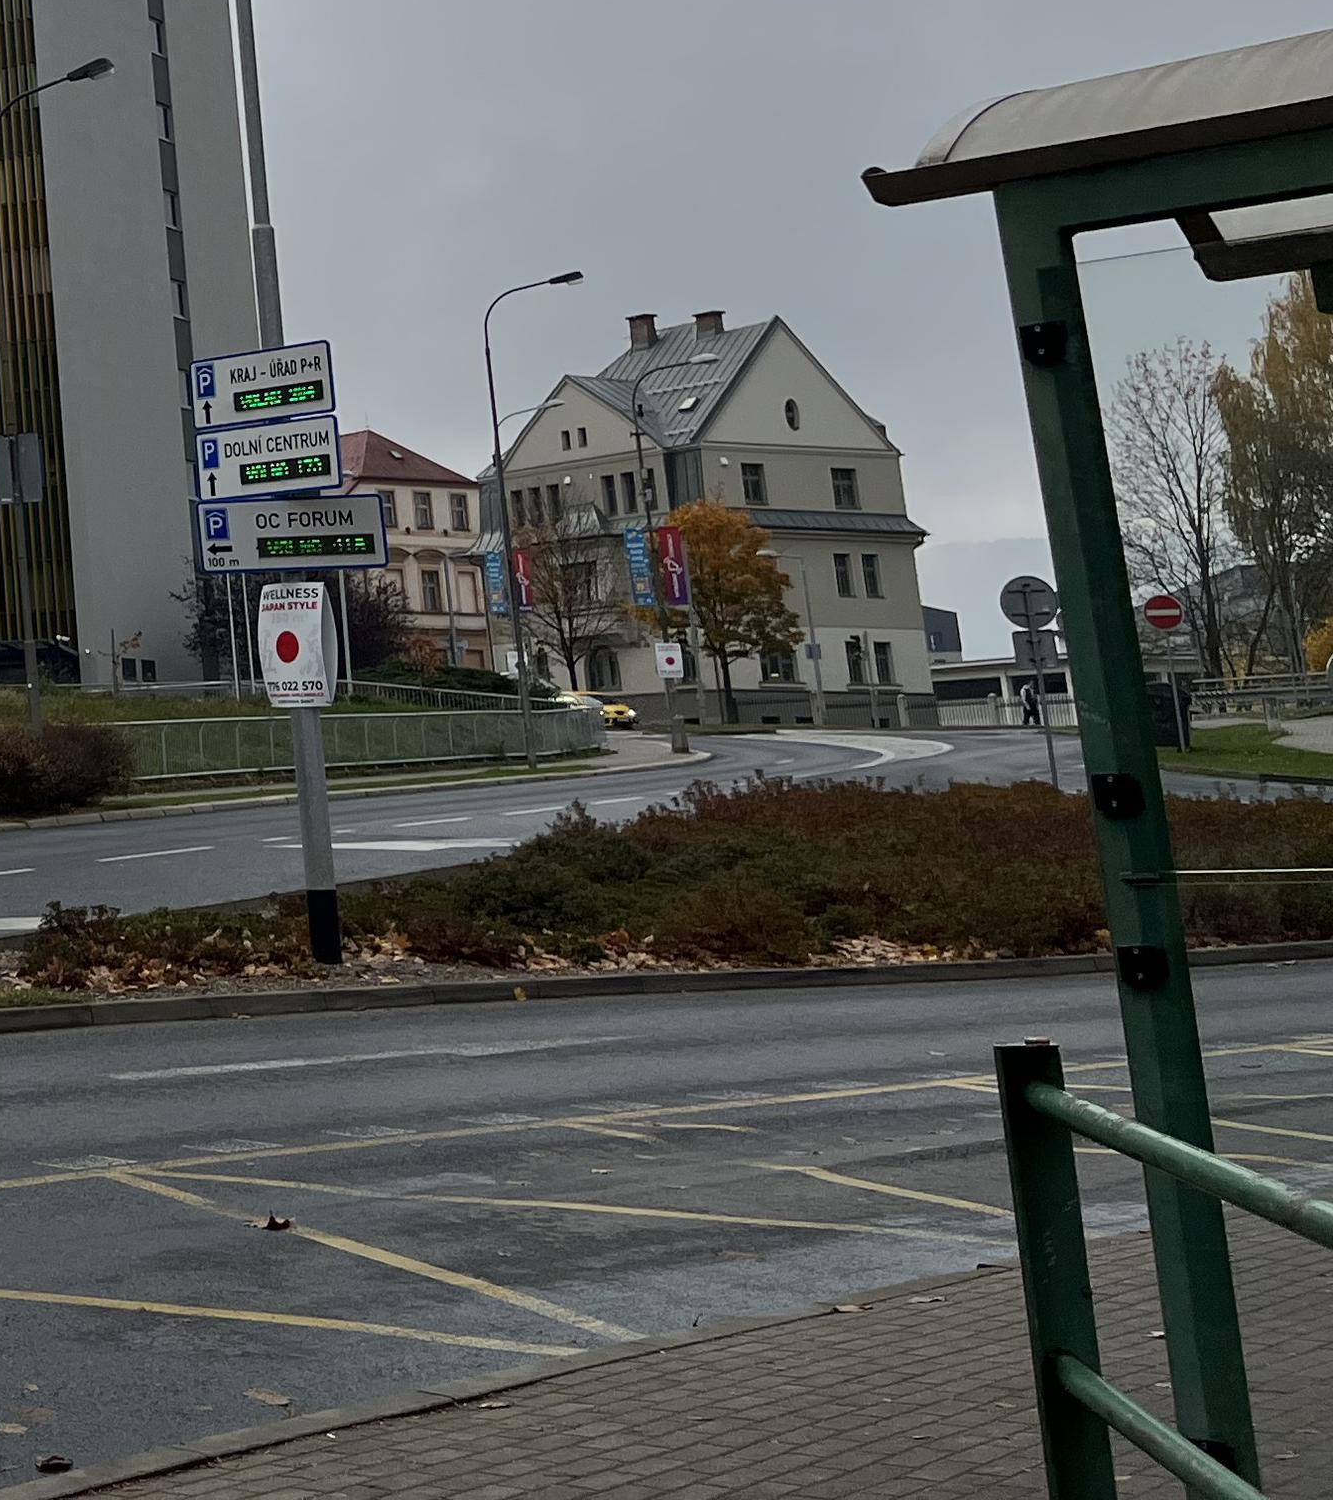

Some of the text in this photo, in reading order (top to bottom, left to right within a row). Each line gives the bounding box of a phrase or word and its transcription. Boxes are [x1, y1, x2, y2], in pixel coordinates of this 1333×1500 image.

[230, 364, 257, 384] KRAJ
[269, 358, 297, 378] ÚŘAD
[300, 356, 321, 373] P+R
[199, 374, 211, 394] P
[203, 442, 215, 461] P
[224, 431, 330, 459] DOLNÍ CENTRUM
[209, 517, 223, 536] P
[255, 510, 354, 530] OC FORUM
[207, 558, 225, 568] 100
[262, 588, 319, 601] WELLNESS
[261, 601, 318, 612] JAPAN STYLE
[281, 681, 299, 691] 022
[302, 680, 324, 691] 570
